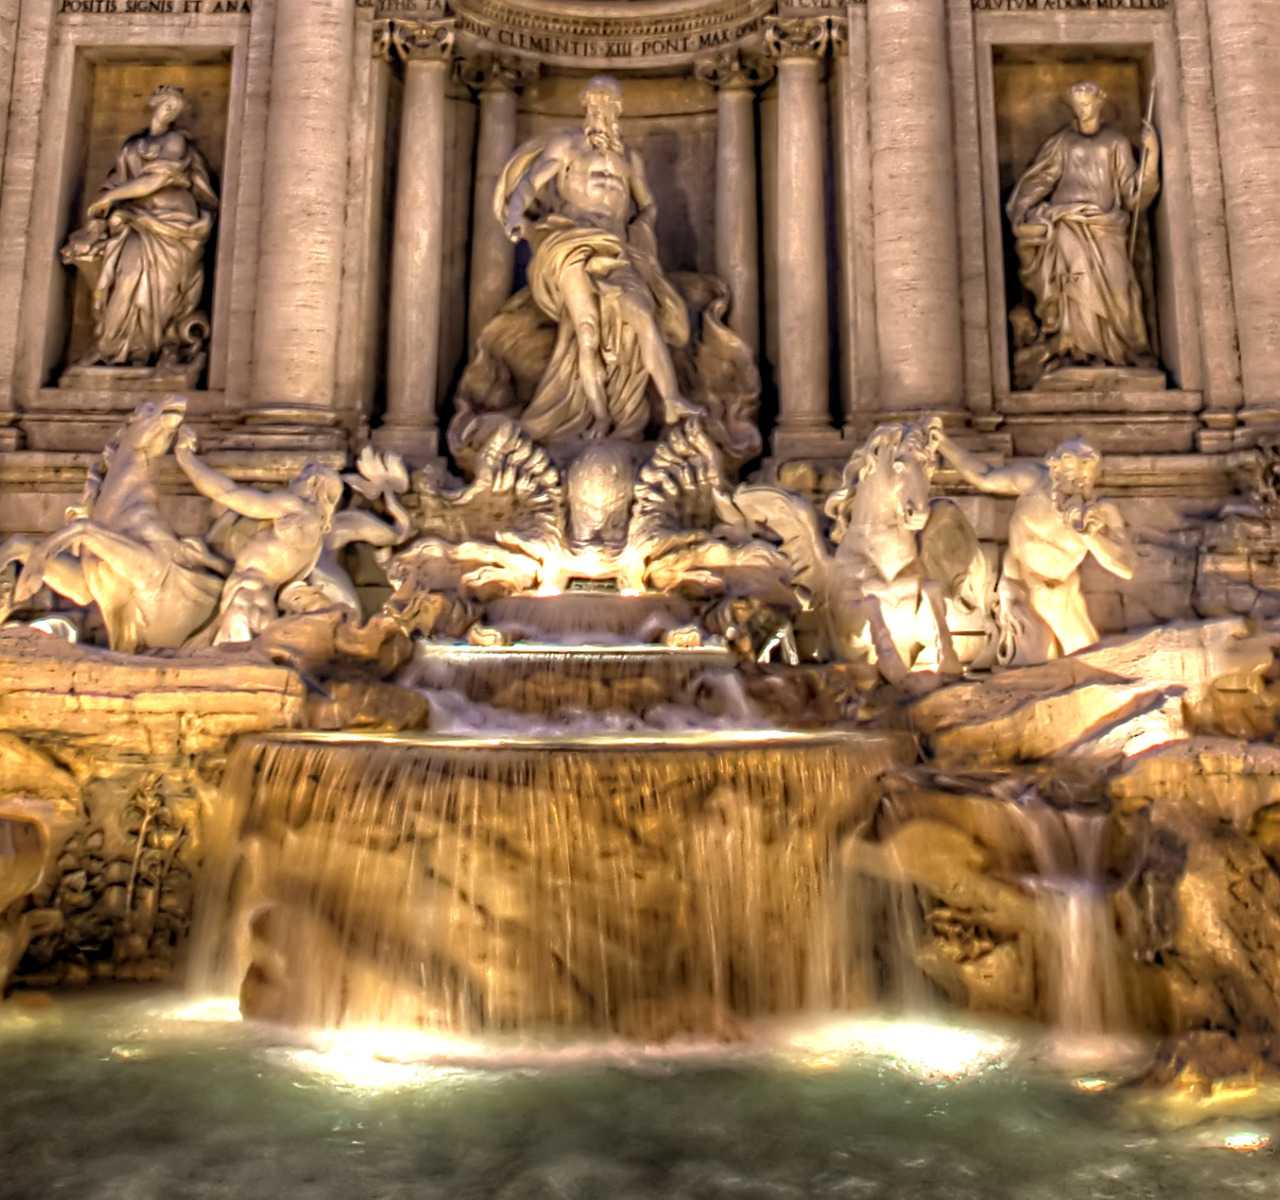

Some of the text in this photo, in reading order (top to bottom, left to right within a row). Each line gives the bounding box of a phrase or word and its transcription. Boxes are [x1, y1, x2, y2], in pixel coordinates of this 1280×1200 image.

[60, 0, 117, 14] POSITIS
[125, 0, 173, 14] SIGNIS
[183, 0, 202, 13] ET
